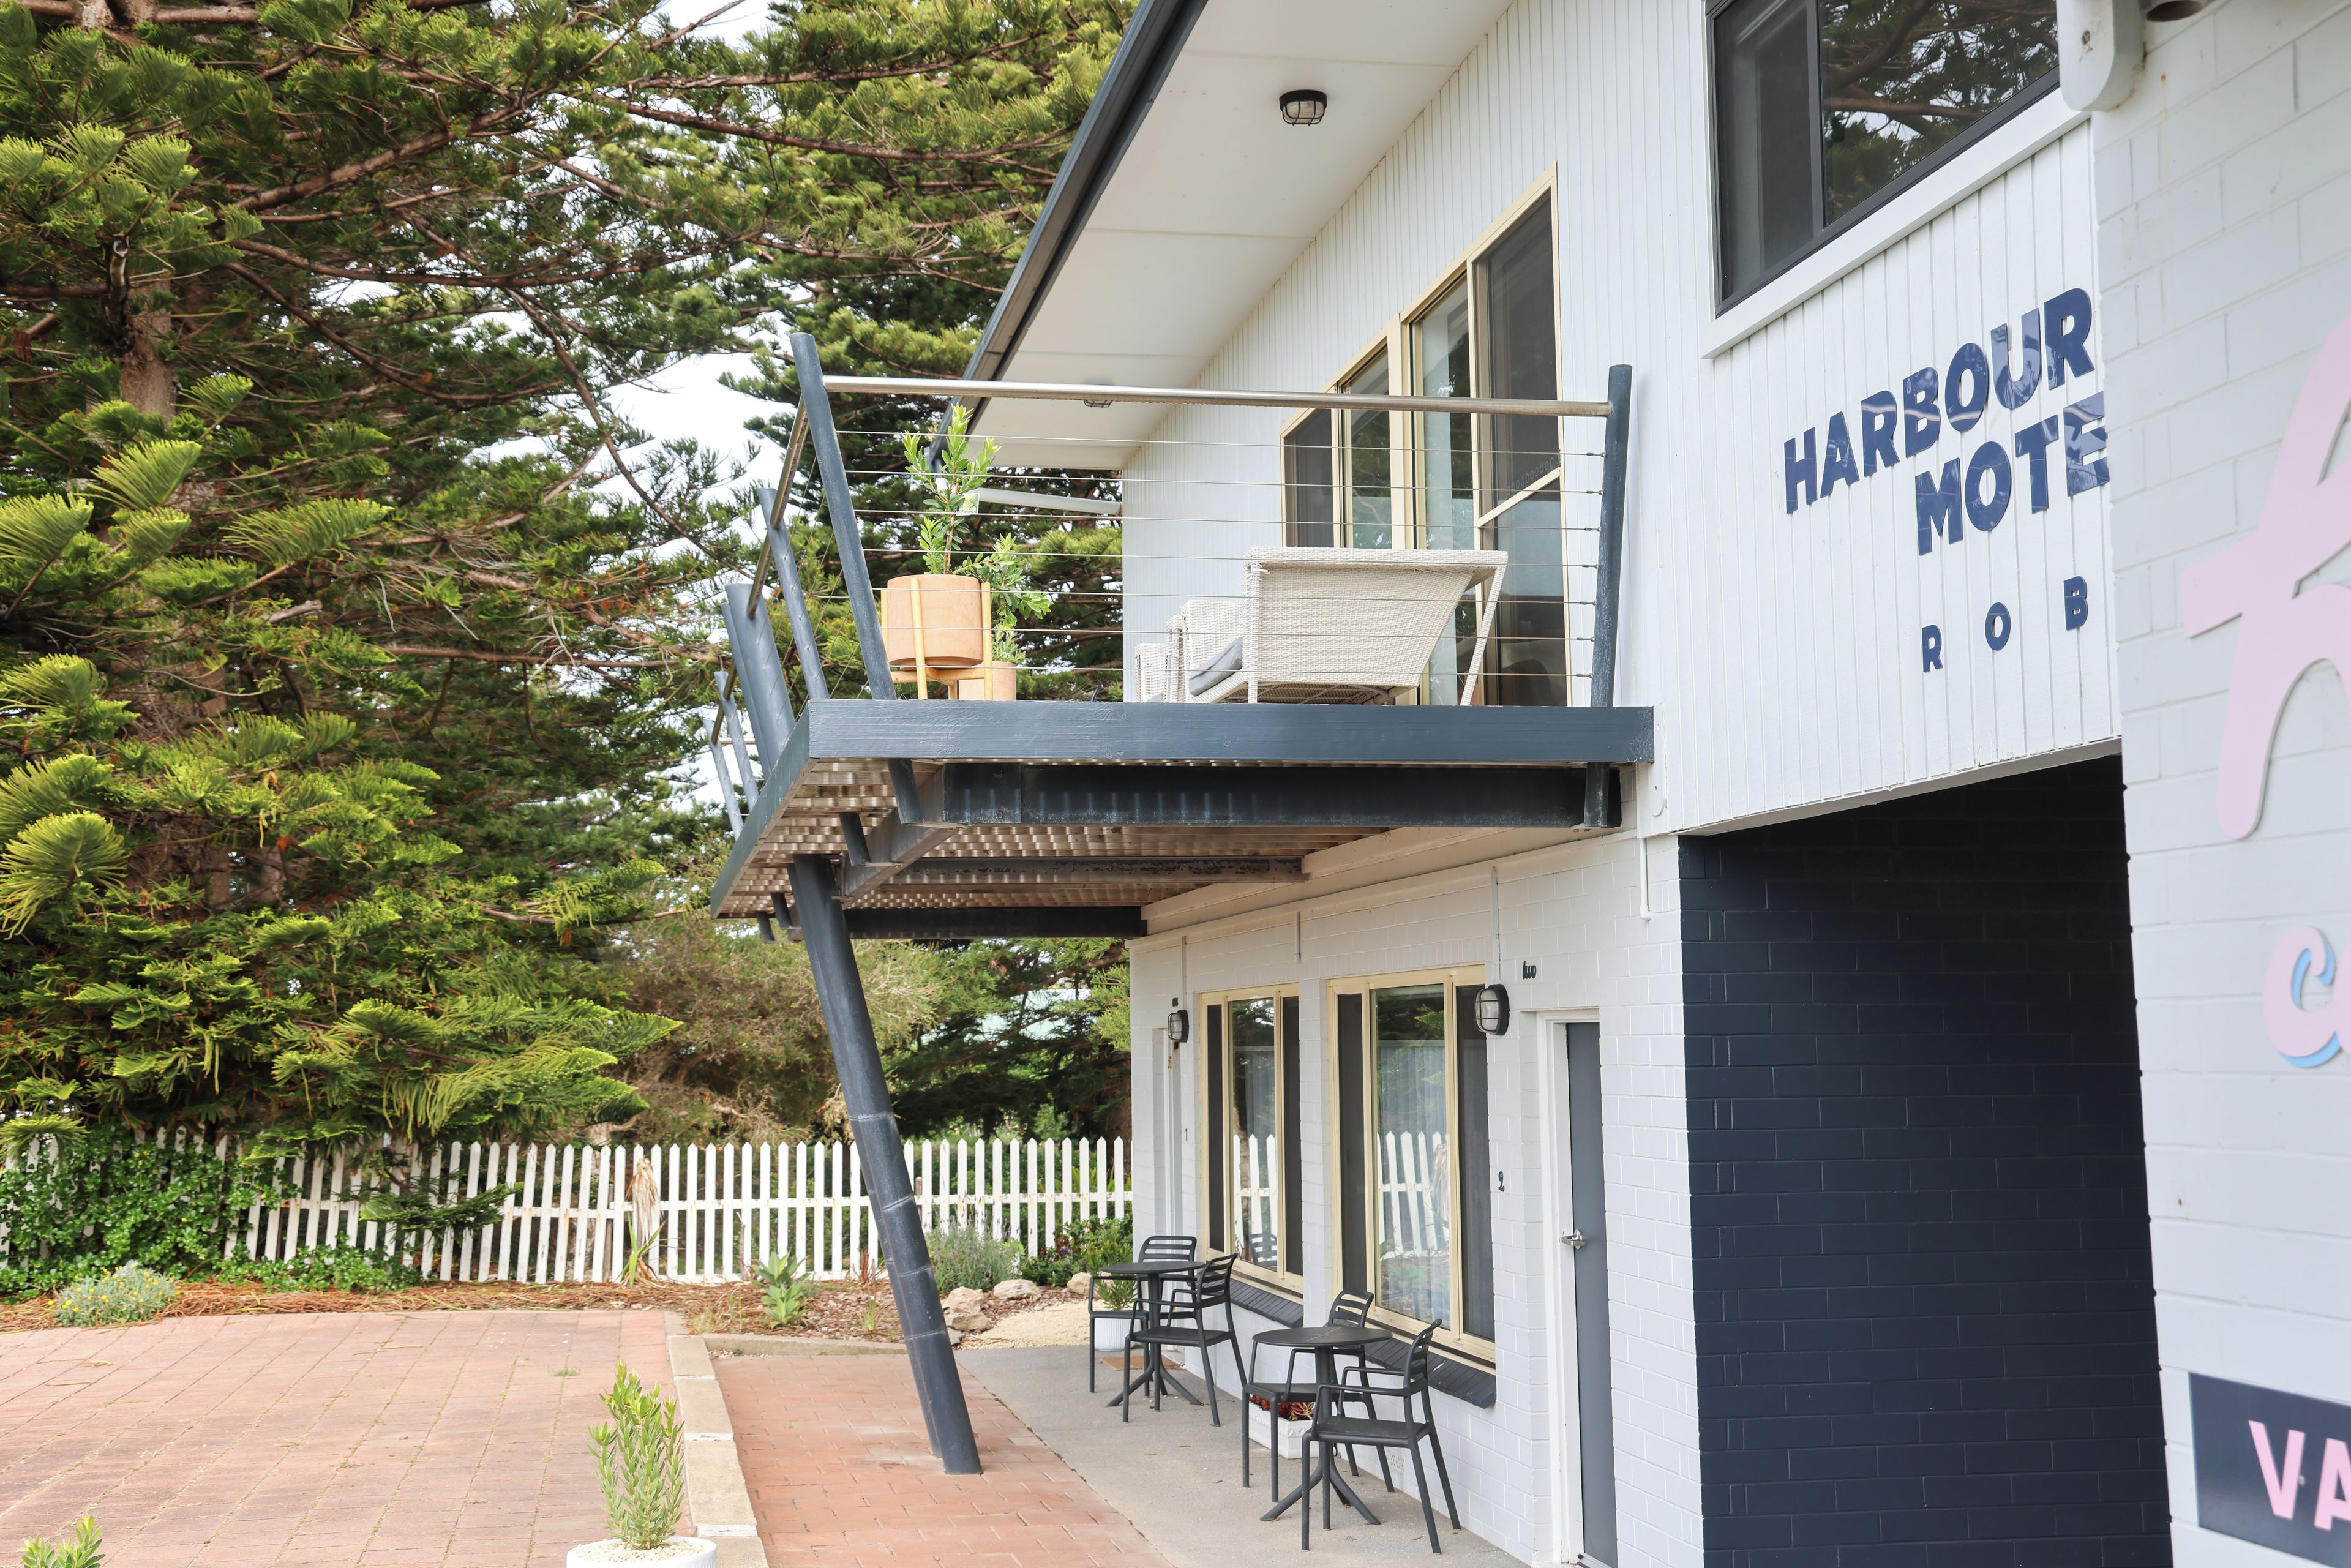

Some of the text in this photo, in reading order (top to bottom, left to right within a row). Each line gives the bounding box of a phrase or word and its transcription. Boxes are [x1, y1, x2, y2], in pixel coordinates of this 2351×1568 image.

[1784, 288, 2095, 514] HARBOUR
[1915, 391, 2110, 557] MOTE
[1922, 576, 2088, 673] ROB
[1522, 961, 1537, 980] two
[1498, 1171, 1505, 1192] 2
[2248, 1420, 2351, 1531] VA
